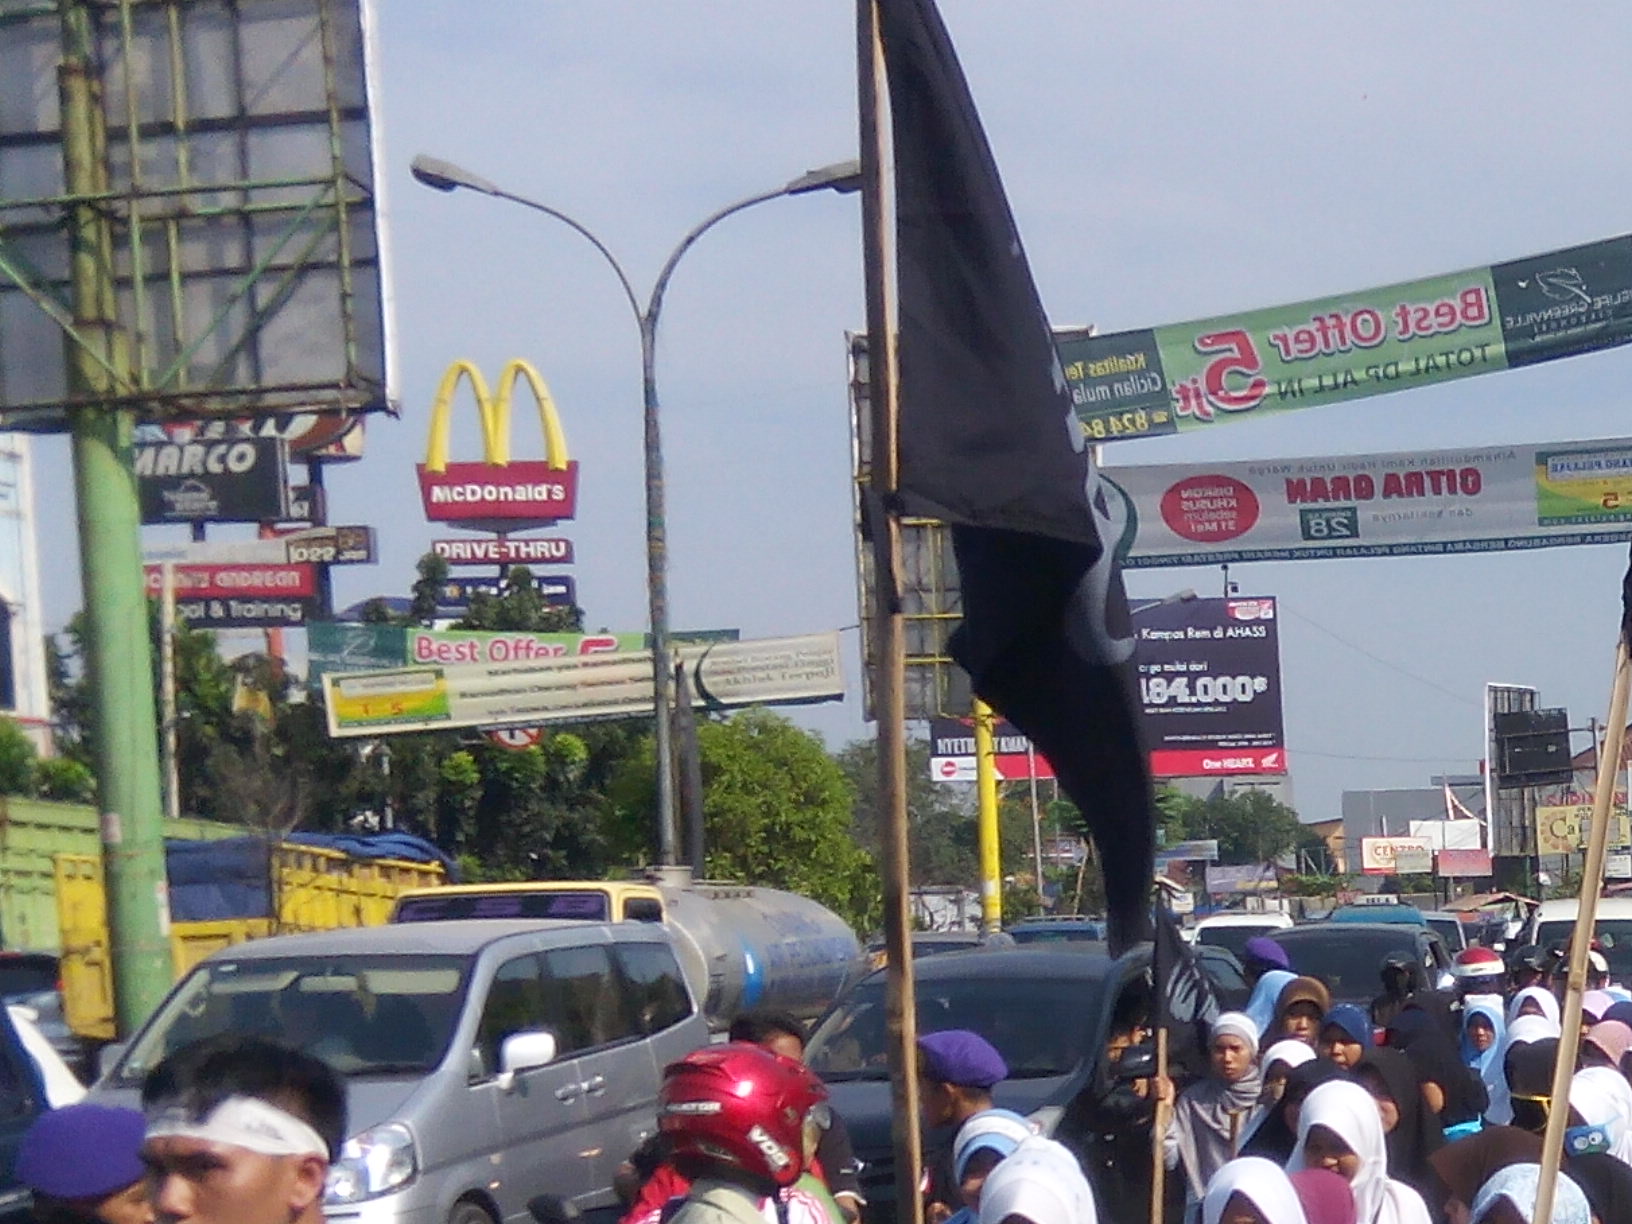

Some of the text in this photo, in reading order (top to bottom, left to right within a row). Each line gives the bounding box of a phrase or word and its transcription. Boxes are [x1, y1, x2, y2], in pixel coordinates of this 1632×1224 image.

[431, 484, 566, 502] McDonald's
[435, 541, 567, 559] DRIVE-THRU
[229, 602, 302, 622] Training
[1213, 626, 1224, 638] di
[416, 635, 567, 662] Best Offer
